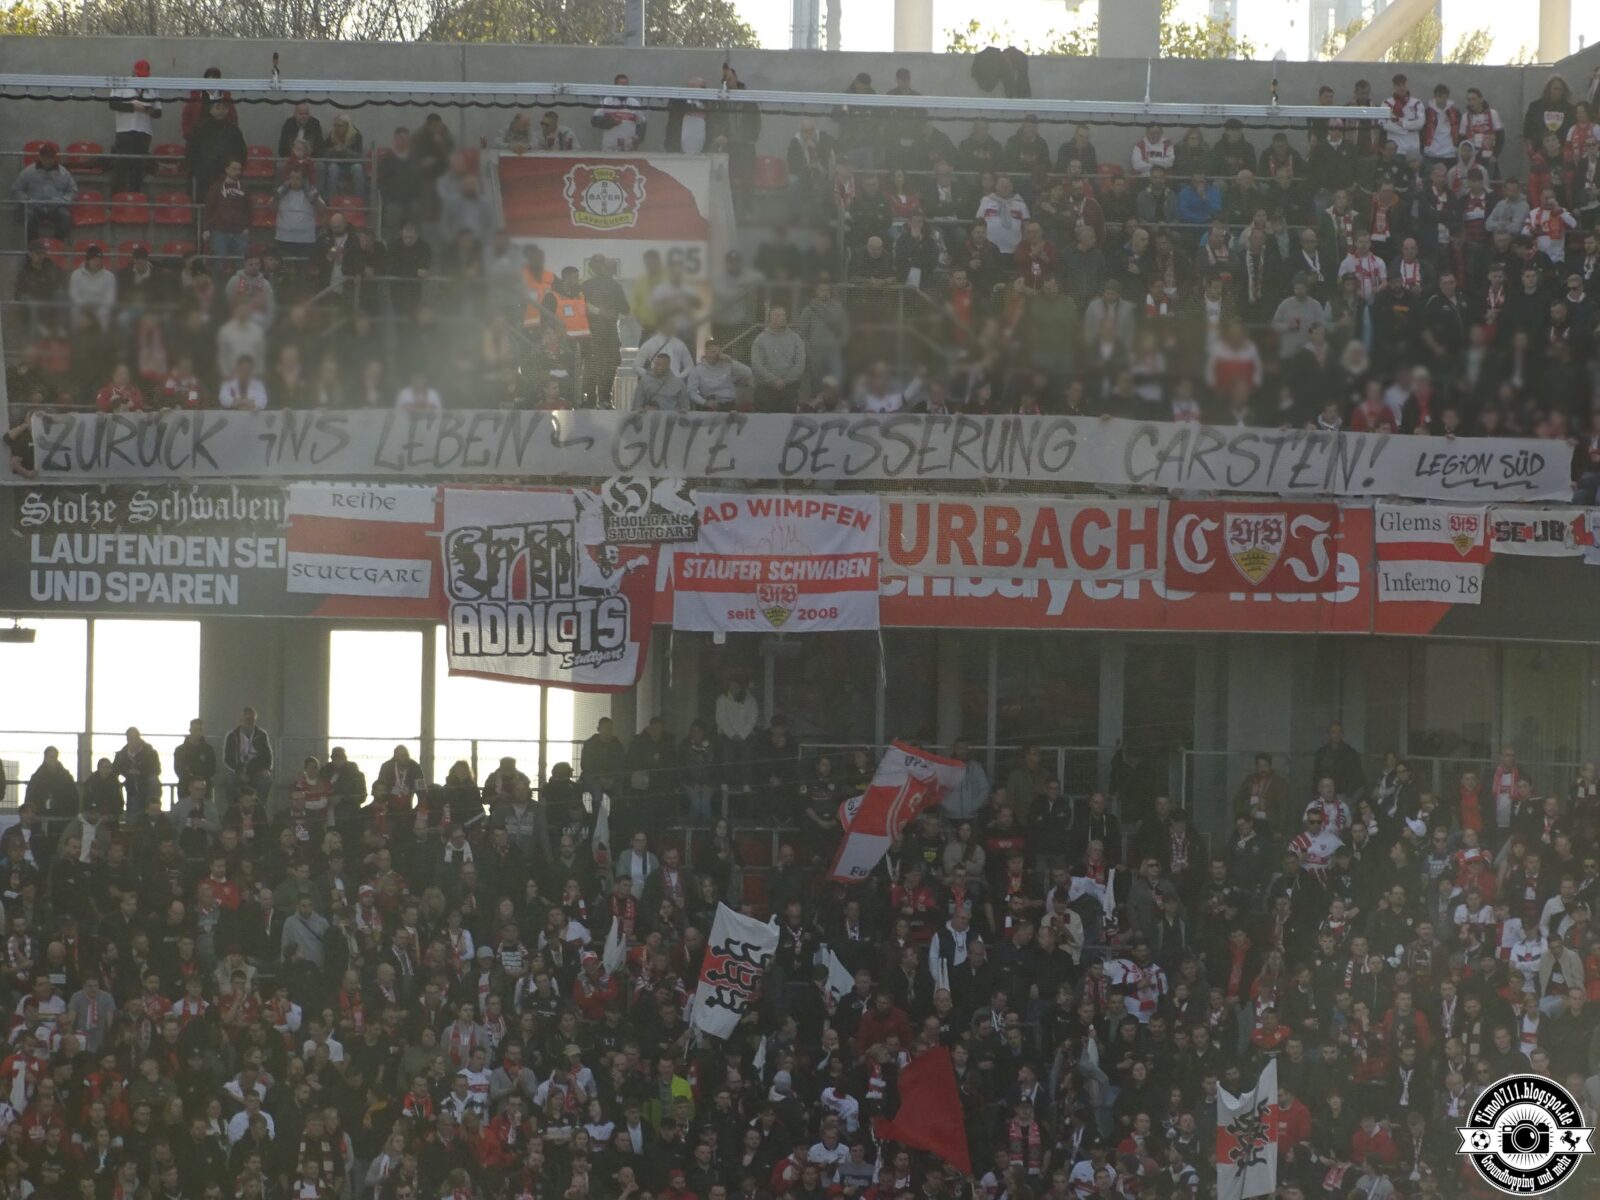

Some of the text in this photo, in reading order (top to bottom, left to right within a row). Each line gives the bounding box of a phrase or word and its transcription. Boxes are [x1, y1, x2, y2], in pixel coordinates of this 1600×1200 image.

[374, 410, 544, 471] LEBEN
[611, 411, 748, 475] GUTE
[779, 414, 1077, 476] BESSERUNG
[1123, 425, 1391, 491] CARSTEN!
[1500, 450, 1545, 478] SÜD
[20, 491, 117, 529] Stolze
[610, 514, 690, 528] HOOLIGANS
[697, 499, 872, 532] AD WIMPFEN
[1380, 511, 1441, 532] Glems
[608, 526, 695, 540] STUTTGART
[887, 502, 1159, 571] URBACH
[31, 533, 230, 568] LAUFENDEN
[682, 557, 872, 582] STAUFER SCHWABEN
[1383, 571, 1450, 593] Inferno
[30, 570, 239, 605] UND SPAREN
[727, 607, 838, 621] seit 2008
